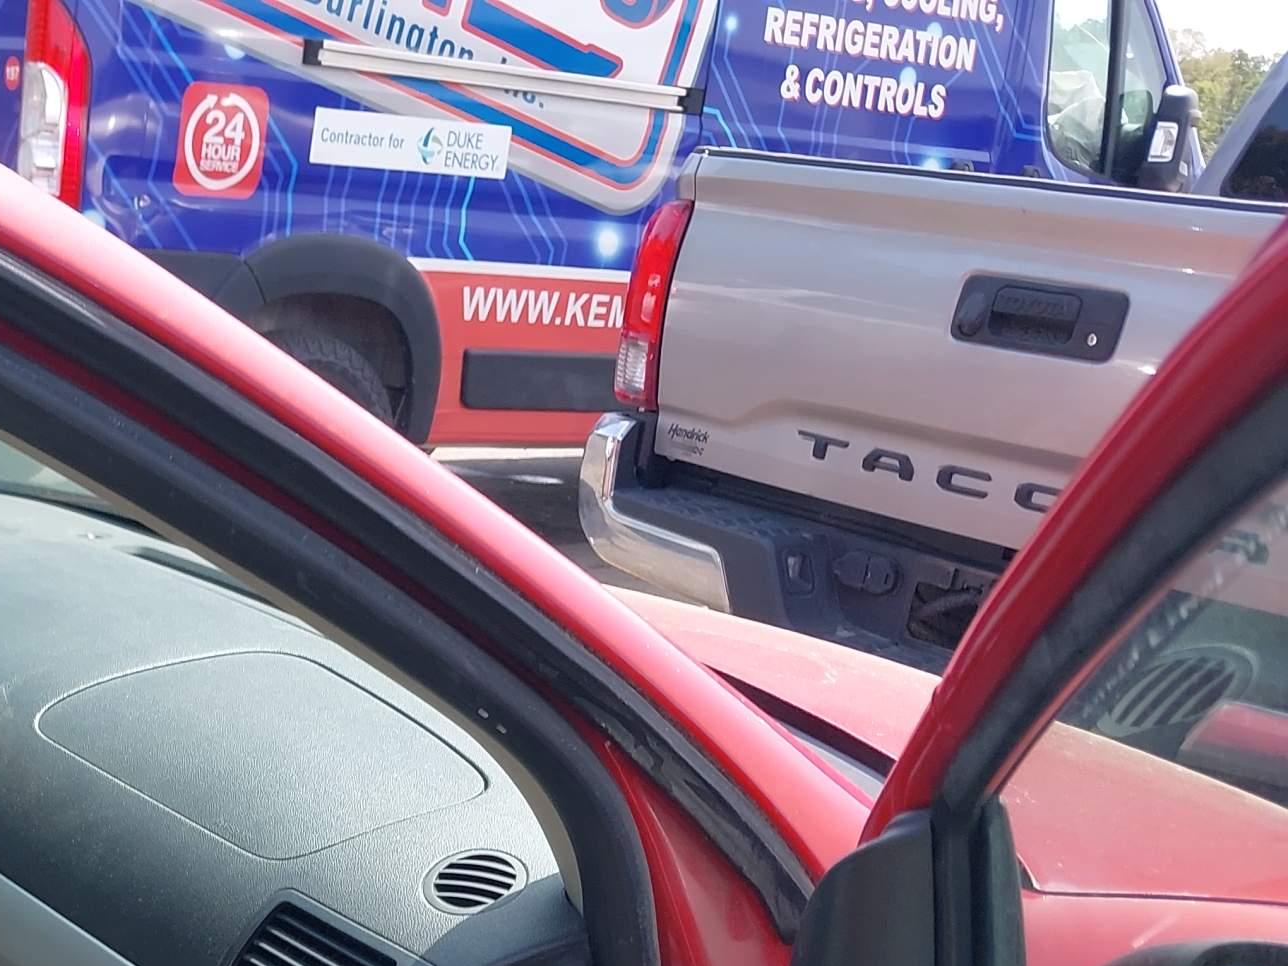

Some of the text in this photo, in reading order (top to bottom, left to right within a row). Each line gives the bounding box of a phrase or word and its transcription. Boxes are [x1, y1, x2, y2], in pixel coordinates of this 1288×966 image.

[764, 6, 977, 72] REFRIGERATION
[780, 64, 947, 120] & CONTROLS
[203, 109, 246, 147] 24
[321, 127, 405, 150] Contractor for
[446, 130, 485, 150] DUKE
[201, 141, 241, 162] HOUR
[444, 151, 499, 172] ENERGY
[668, 423, 710, 444] Hendrick
